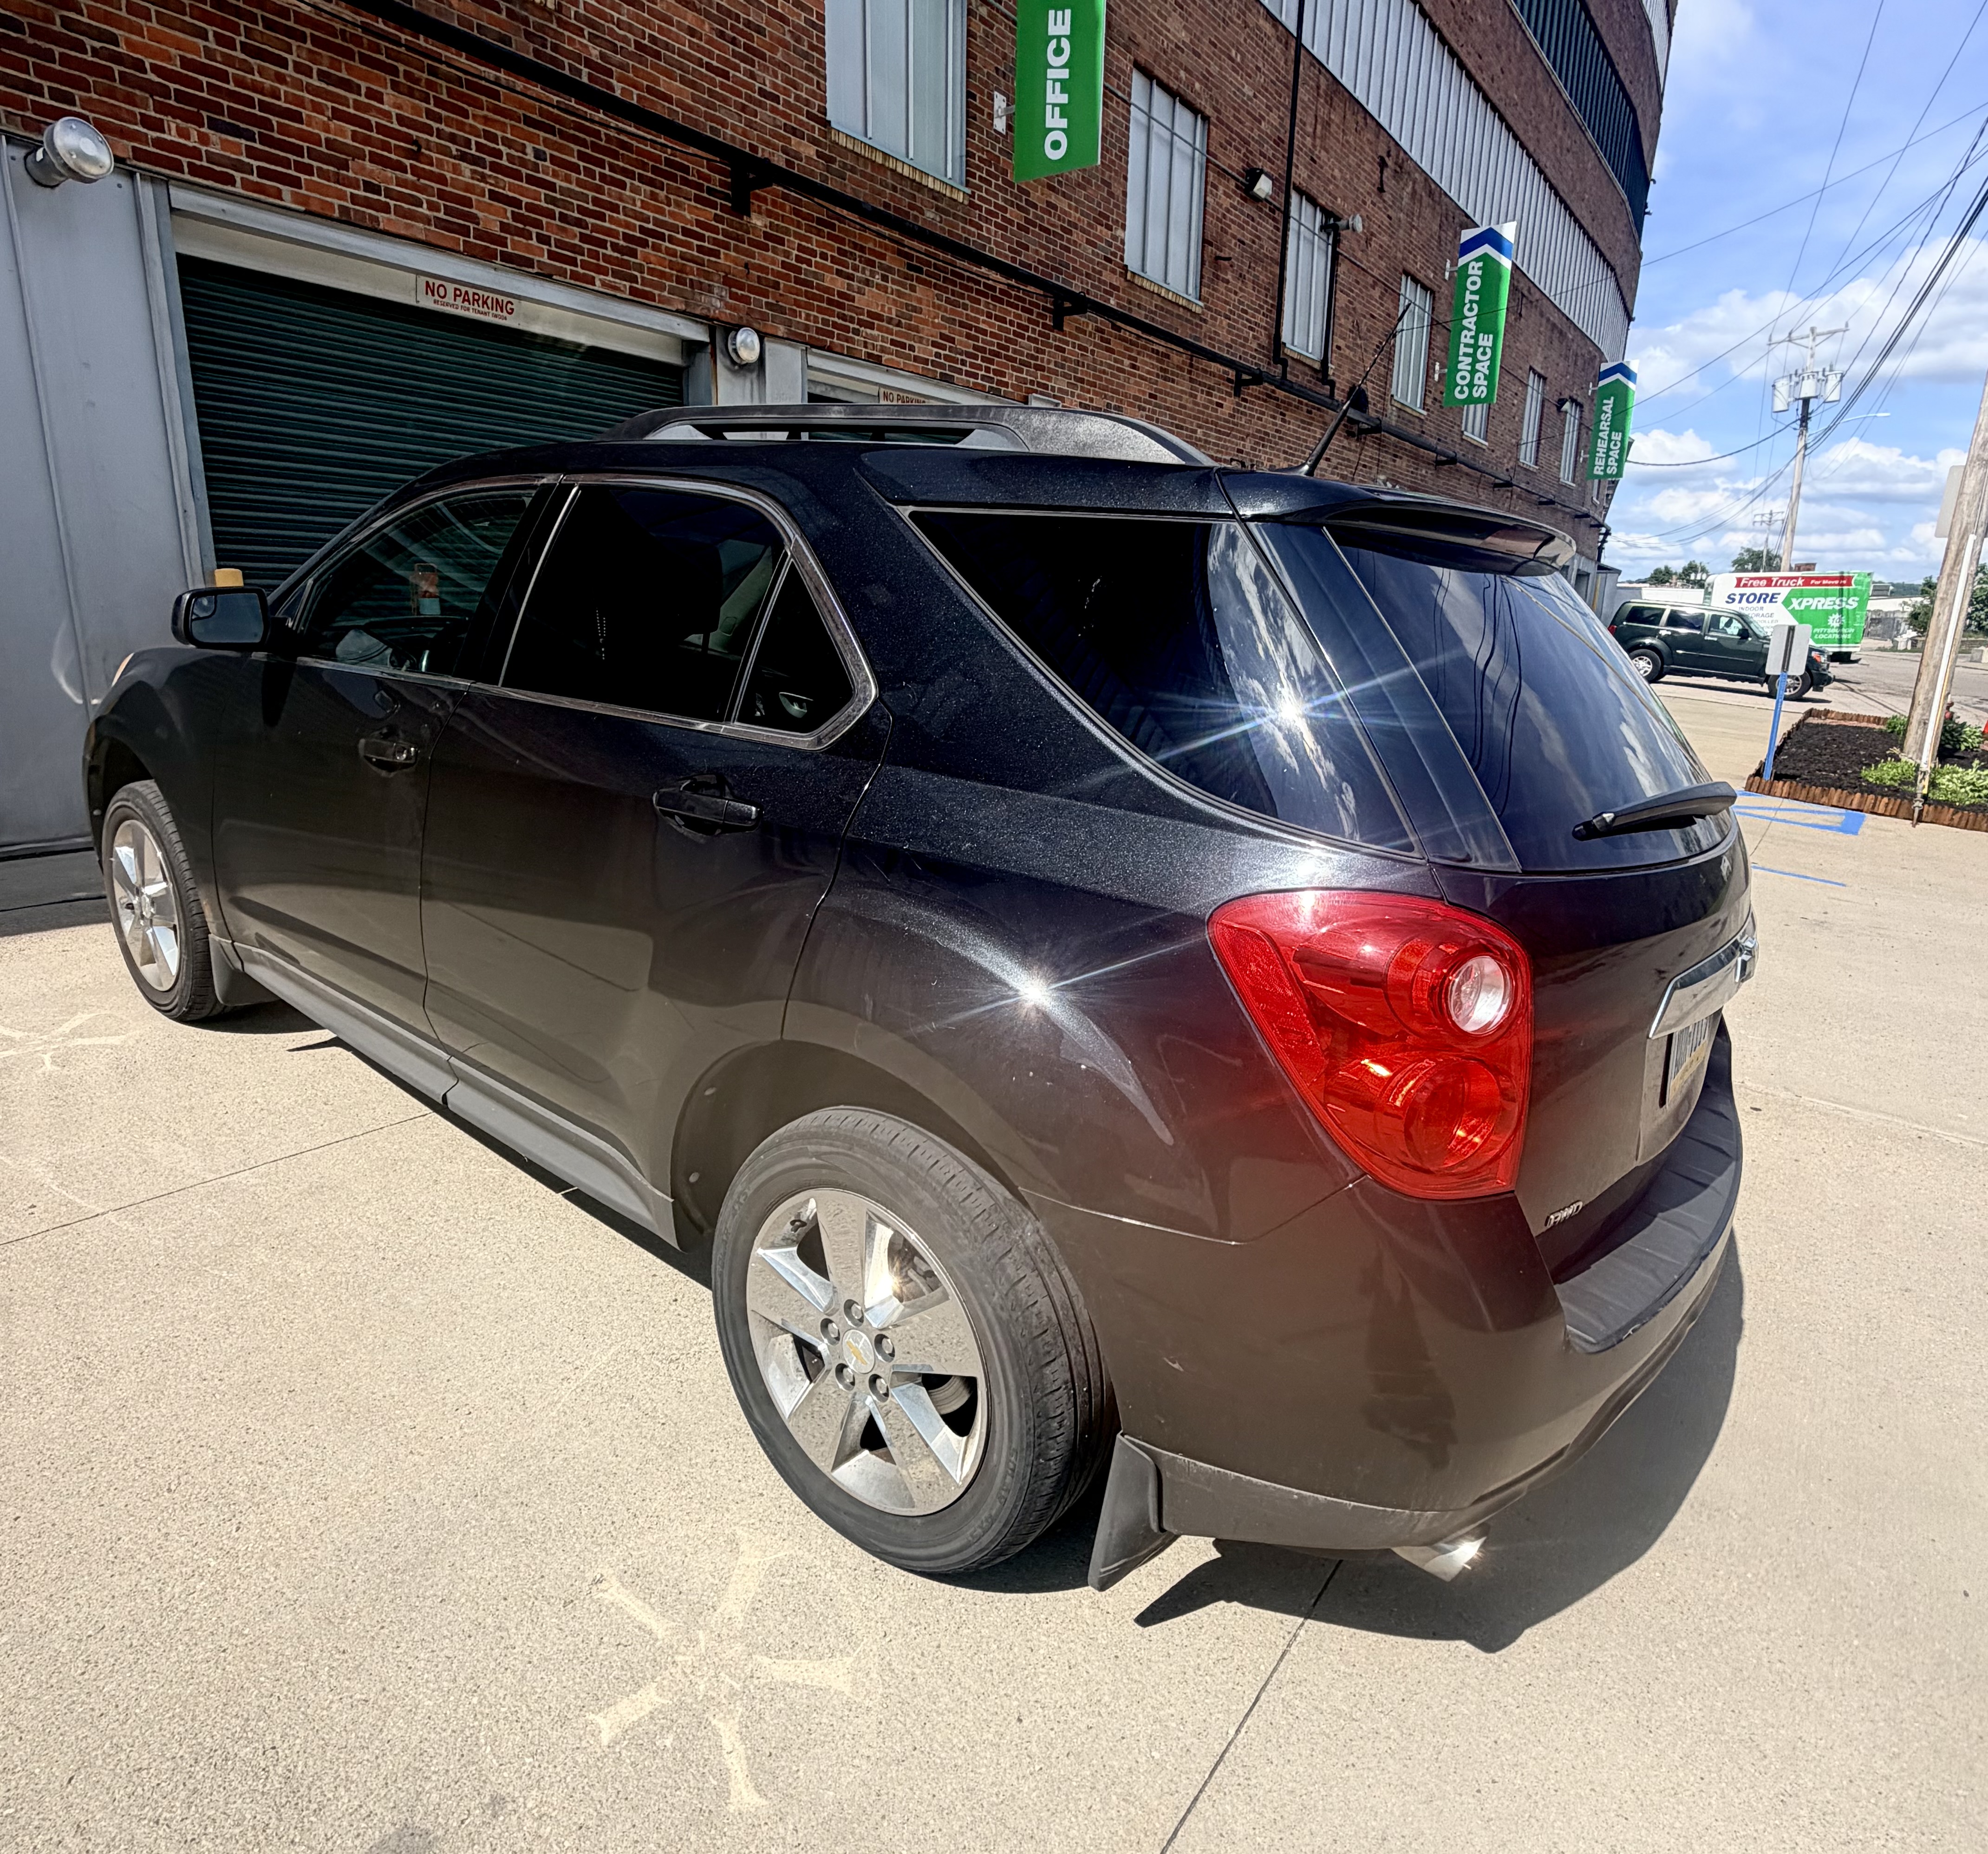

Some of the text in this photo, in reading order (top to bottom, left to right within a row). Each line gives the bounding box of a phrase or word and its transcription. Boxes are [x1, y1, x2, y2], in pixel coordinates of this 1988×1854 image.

[1044, 9, 1071, 160] OFFICE
[425, 281, 515, 315] NO PARKING
[433, 299, 459, 310] RESERVED
[1454, 261, 1483, 399] CONTRACTOR
[1473, 333, 1493, 399] SPACE
[883, 390, 926, 404] NO PARKIN
[1593, 396, 1614, 475] REHEARSAL
[1606, 431, 1622, 475] SPACE
[1725, 593, 1860, 610] STORE XPRESS
[1740, 577, 1767, 587] Free
[1771, 577, 1805, 587] Truck
